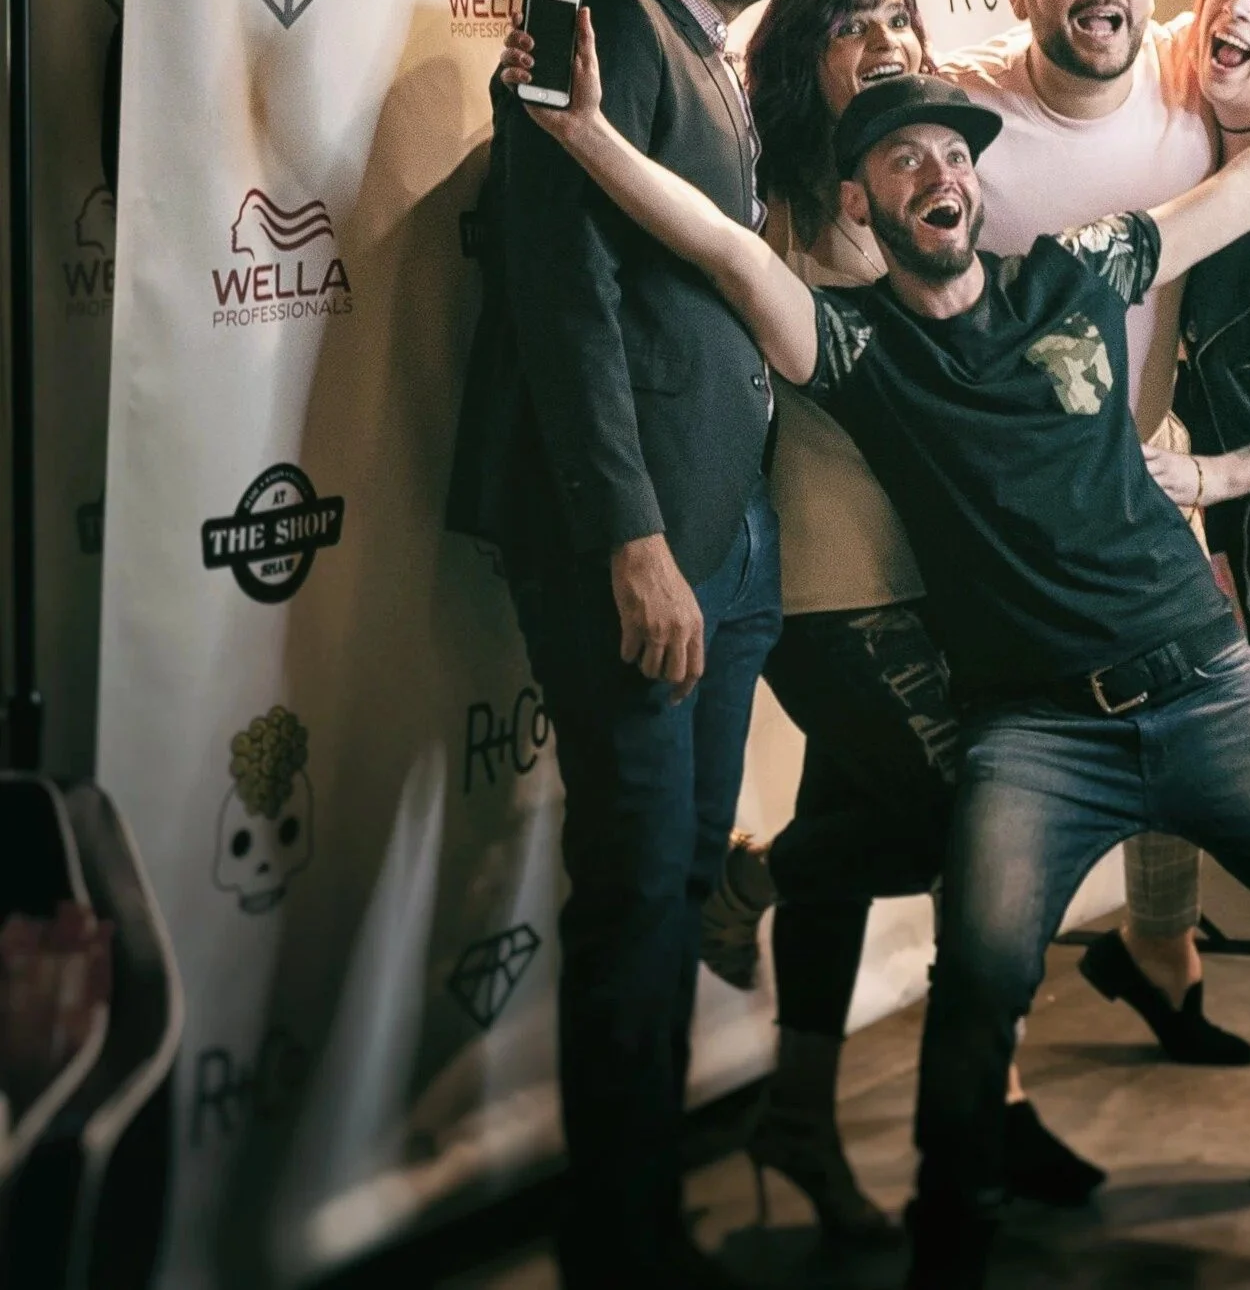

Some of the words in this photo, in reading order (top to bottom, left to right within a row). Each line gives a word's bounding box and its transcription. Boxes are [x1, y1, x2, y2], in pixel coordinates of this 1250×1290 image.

[212, 258, 351, 306] WELLA
[212, 297, 353, 328] PROFESSIONALS
[209, 523, 265, 557] THE
[274, 507, 337, 546] SHOP
[465, 687, 550, 794] R+Co
